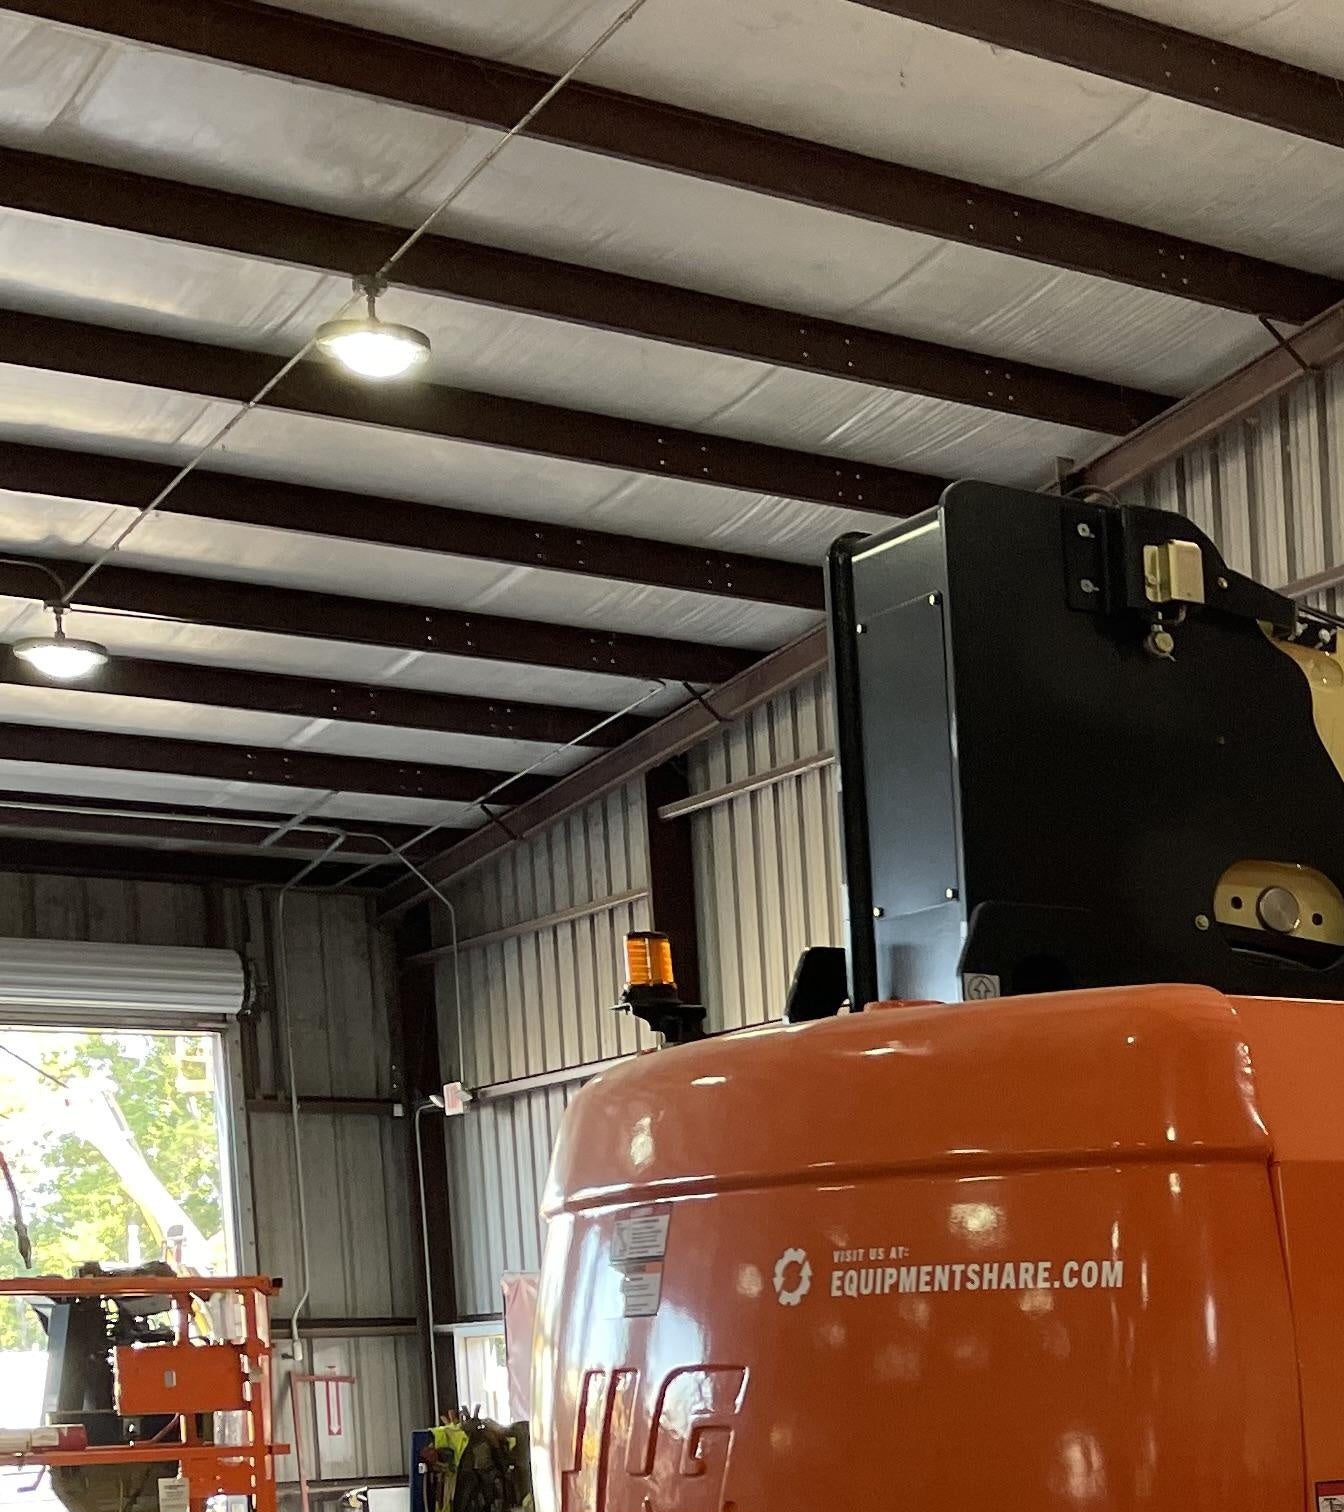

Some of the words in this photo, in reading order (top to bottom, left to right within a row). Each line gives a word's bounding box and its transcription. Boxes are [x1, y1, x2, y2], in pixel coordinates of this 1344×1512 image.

[833, 1249, 865, 1263] VISIT
[869, 1248, 885, 1260] US
[889, 1246, 910, 1259] AT:
[830, 1260, 1124, 1299] EQUIPMENTSHARE.COM
